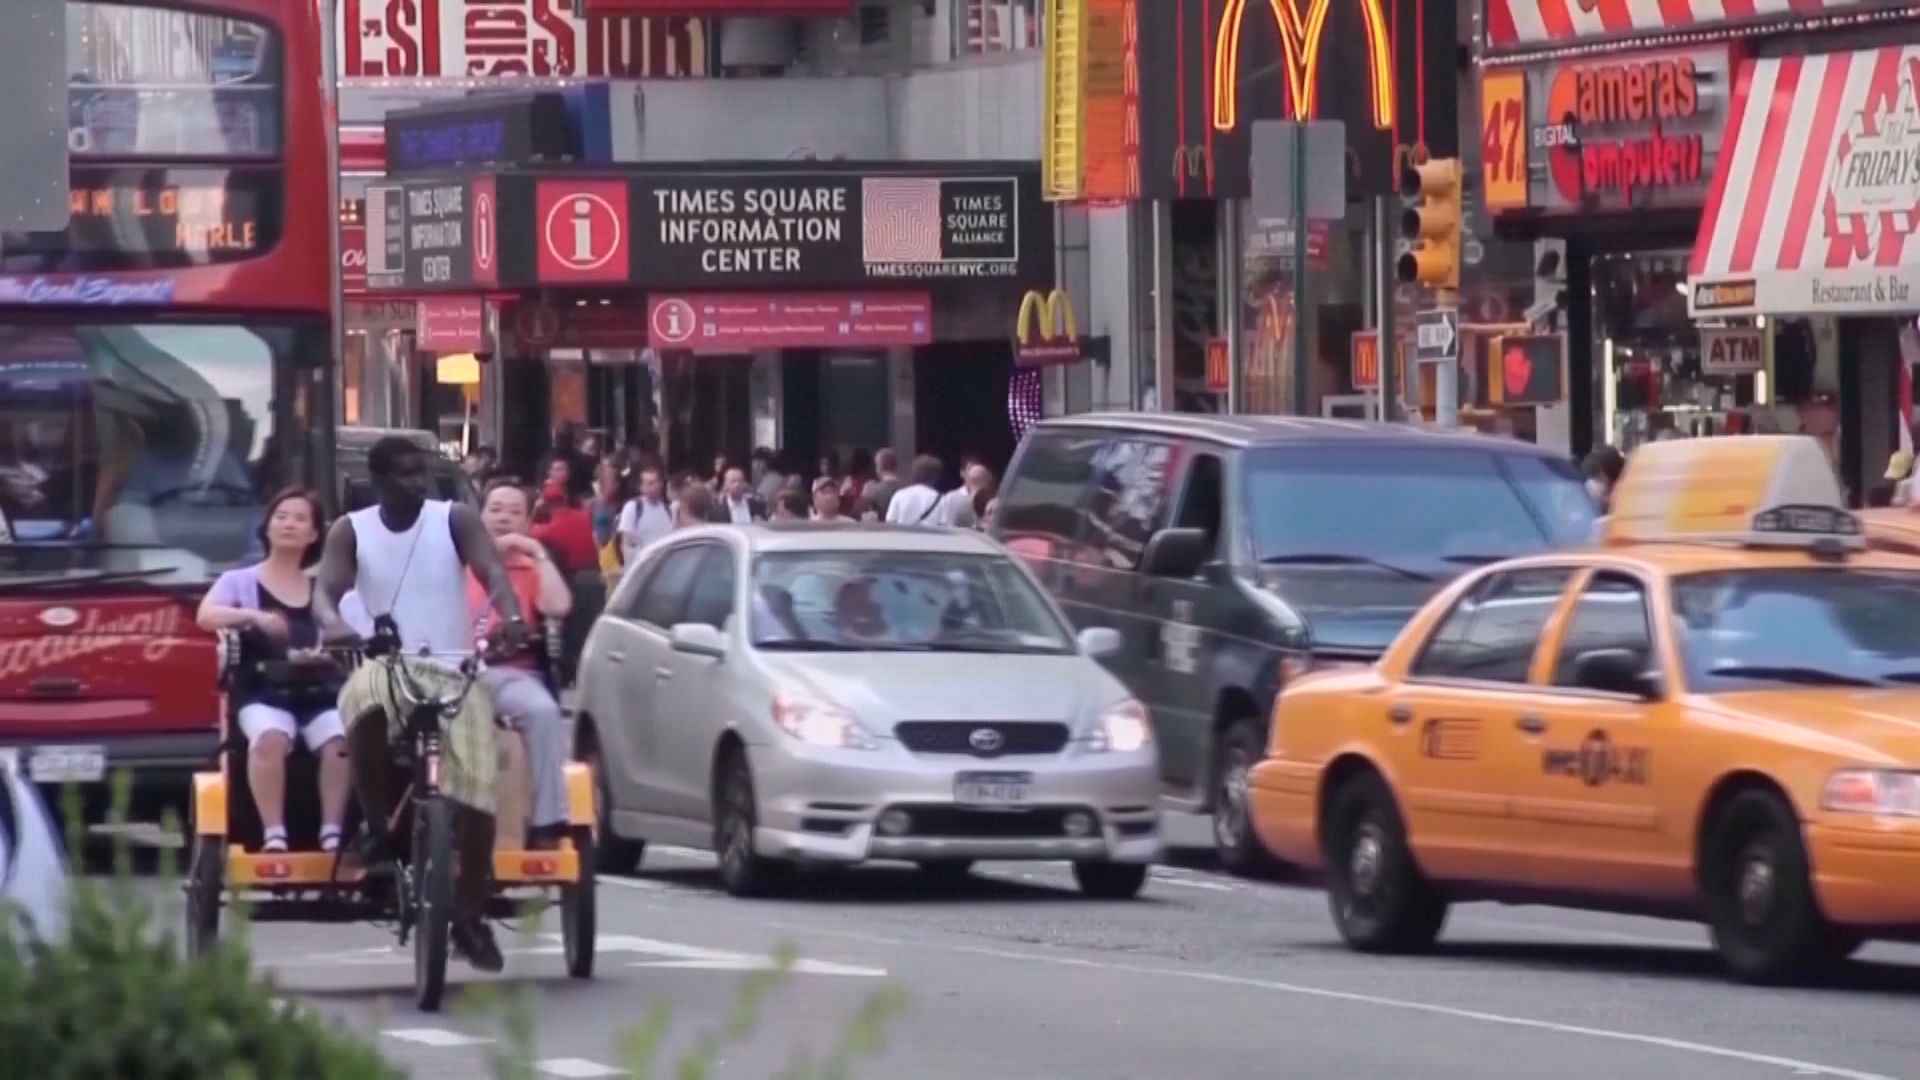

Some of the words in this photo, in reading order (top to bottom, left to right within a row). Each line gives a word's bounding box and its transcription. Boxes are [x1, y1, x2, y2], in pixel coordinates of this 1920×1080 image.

[653, 189, 735, 214] TIMES
[743, 187, 847, 216] SQUARE
[951, 196, 1002, 211] TIMES
[660, 218, 841, 243] INFORMATION
[947, 213, 1007, 230] SQUARE
[951, 231, 1004, 245] ALLIANCE
[702, 247, 801, 272] CENTER
[864, 262, 1017, 278] TIMESSQUARENYC.ORG
[1812, 278, 1873, 304] Restaurant
[1874, 276, 1885, 302] &
[1889, 276, 1910, 302] Bar
[1709, 336, 1761, 364] ATM
